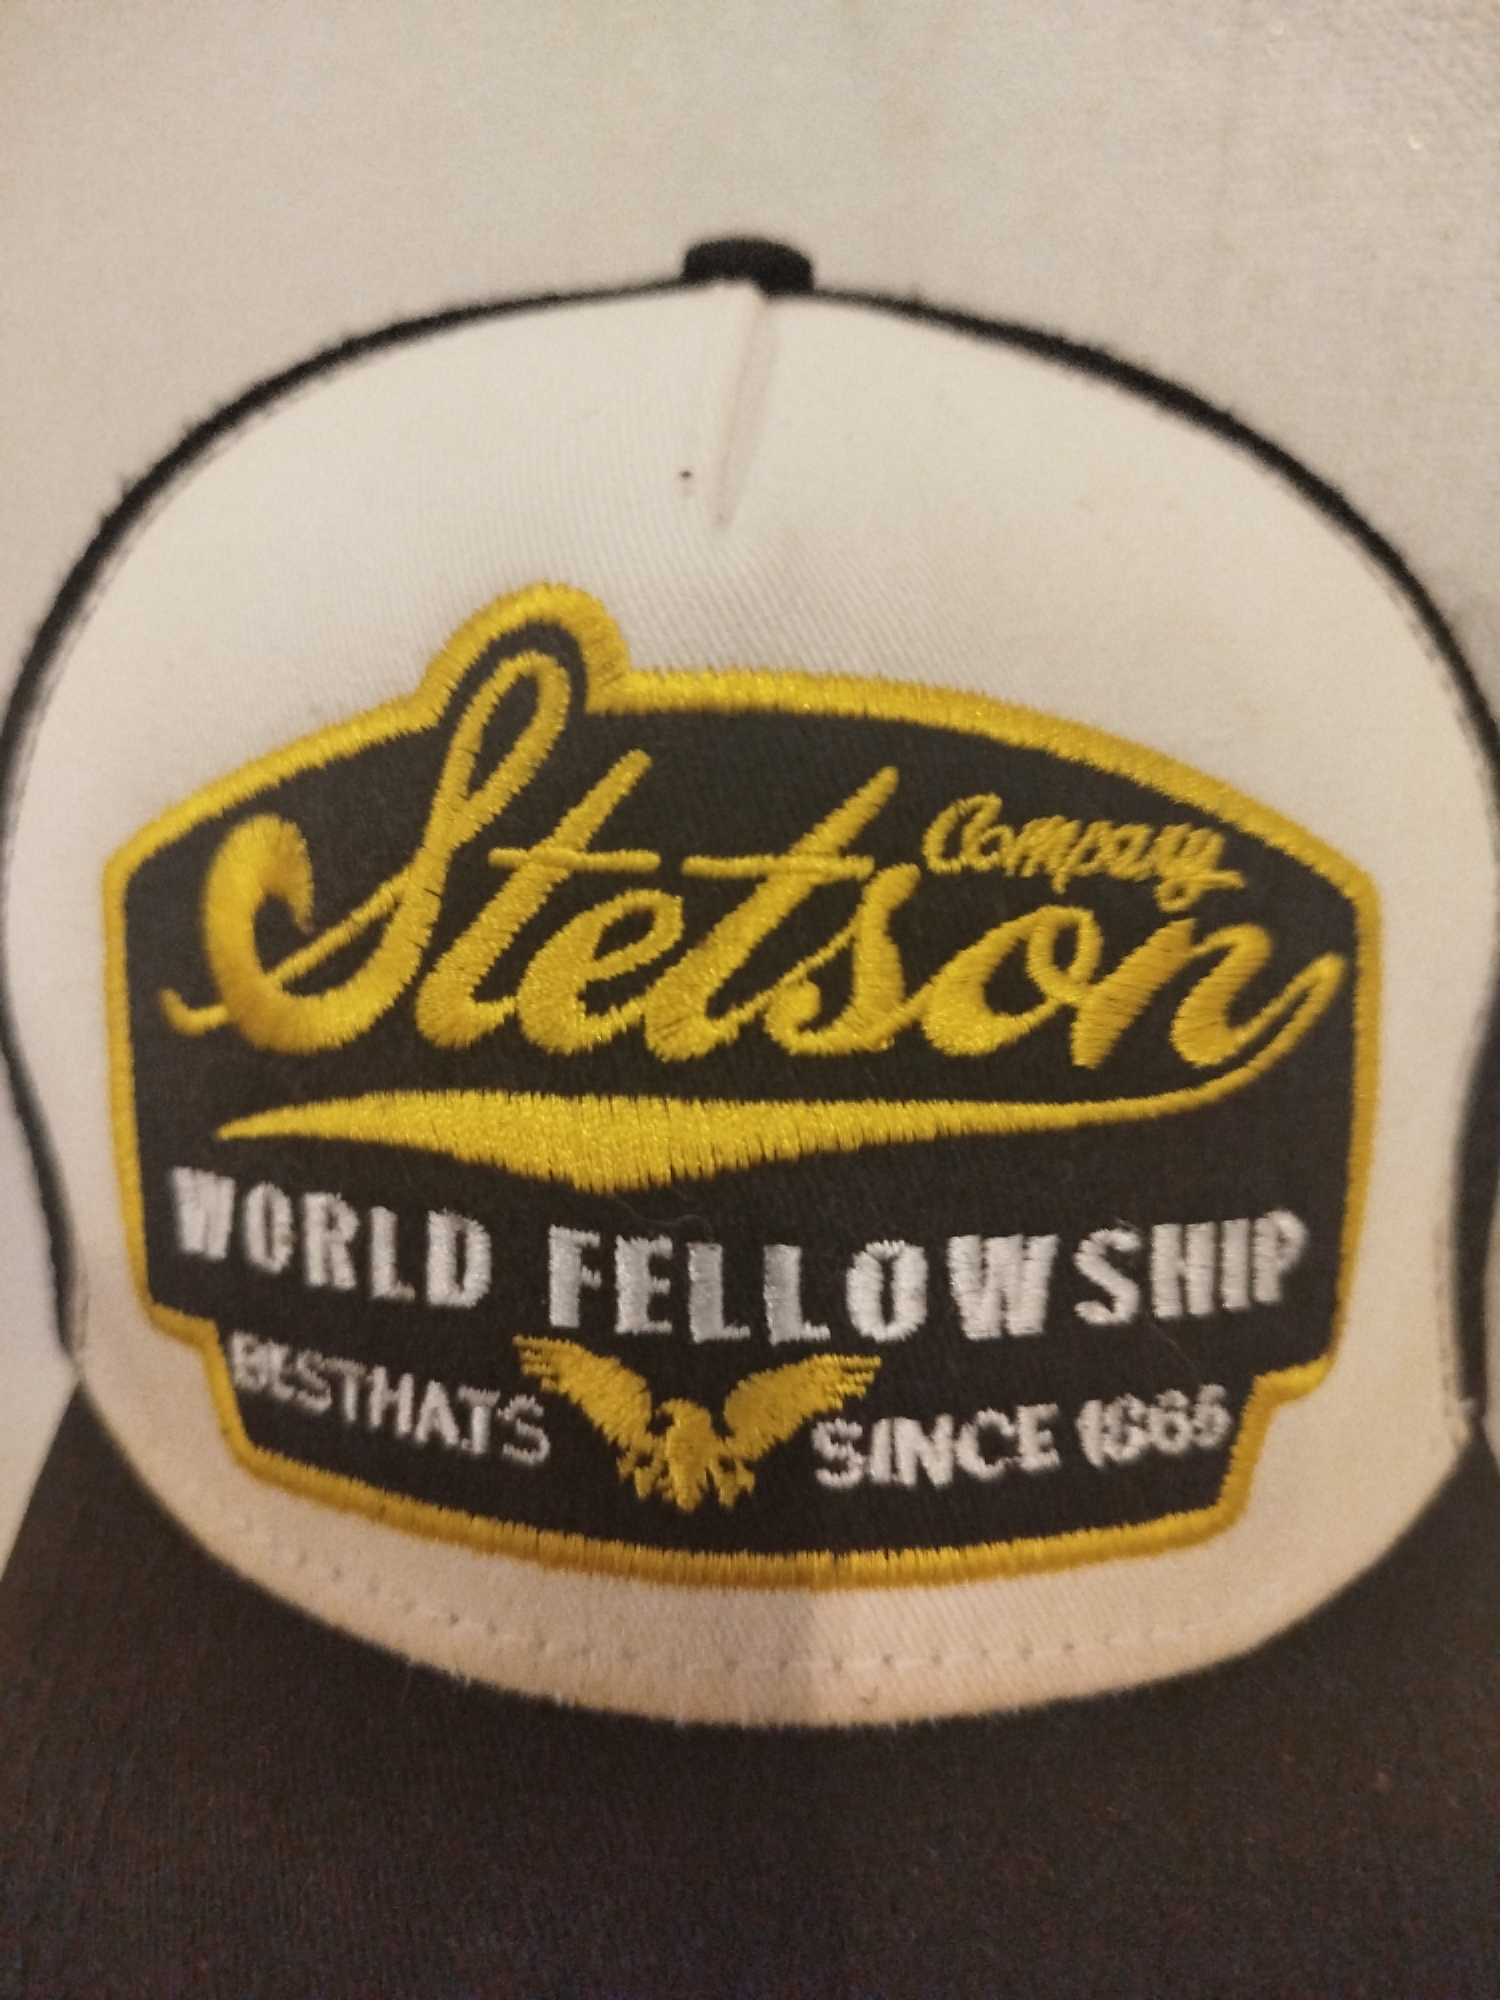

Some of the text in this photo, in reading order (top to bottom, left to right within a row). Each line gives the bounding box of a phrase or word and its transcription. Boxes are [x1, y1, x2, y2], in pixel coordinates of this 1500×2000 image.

[161, 650, 1345, 1068] Stetson
[922, 792, 1245, 913] Company
[171, 1166, 1308, 1345] WORLD FELLOWSHIP
[812, 1403, 1060, 1489] SINCE
